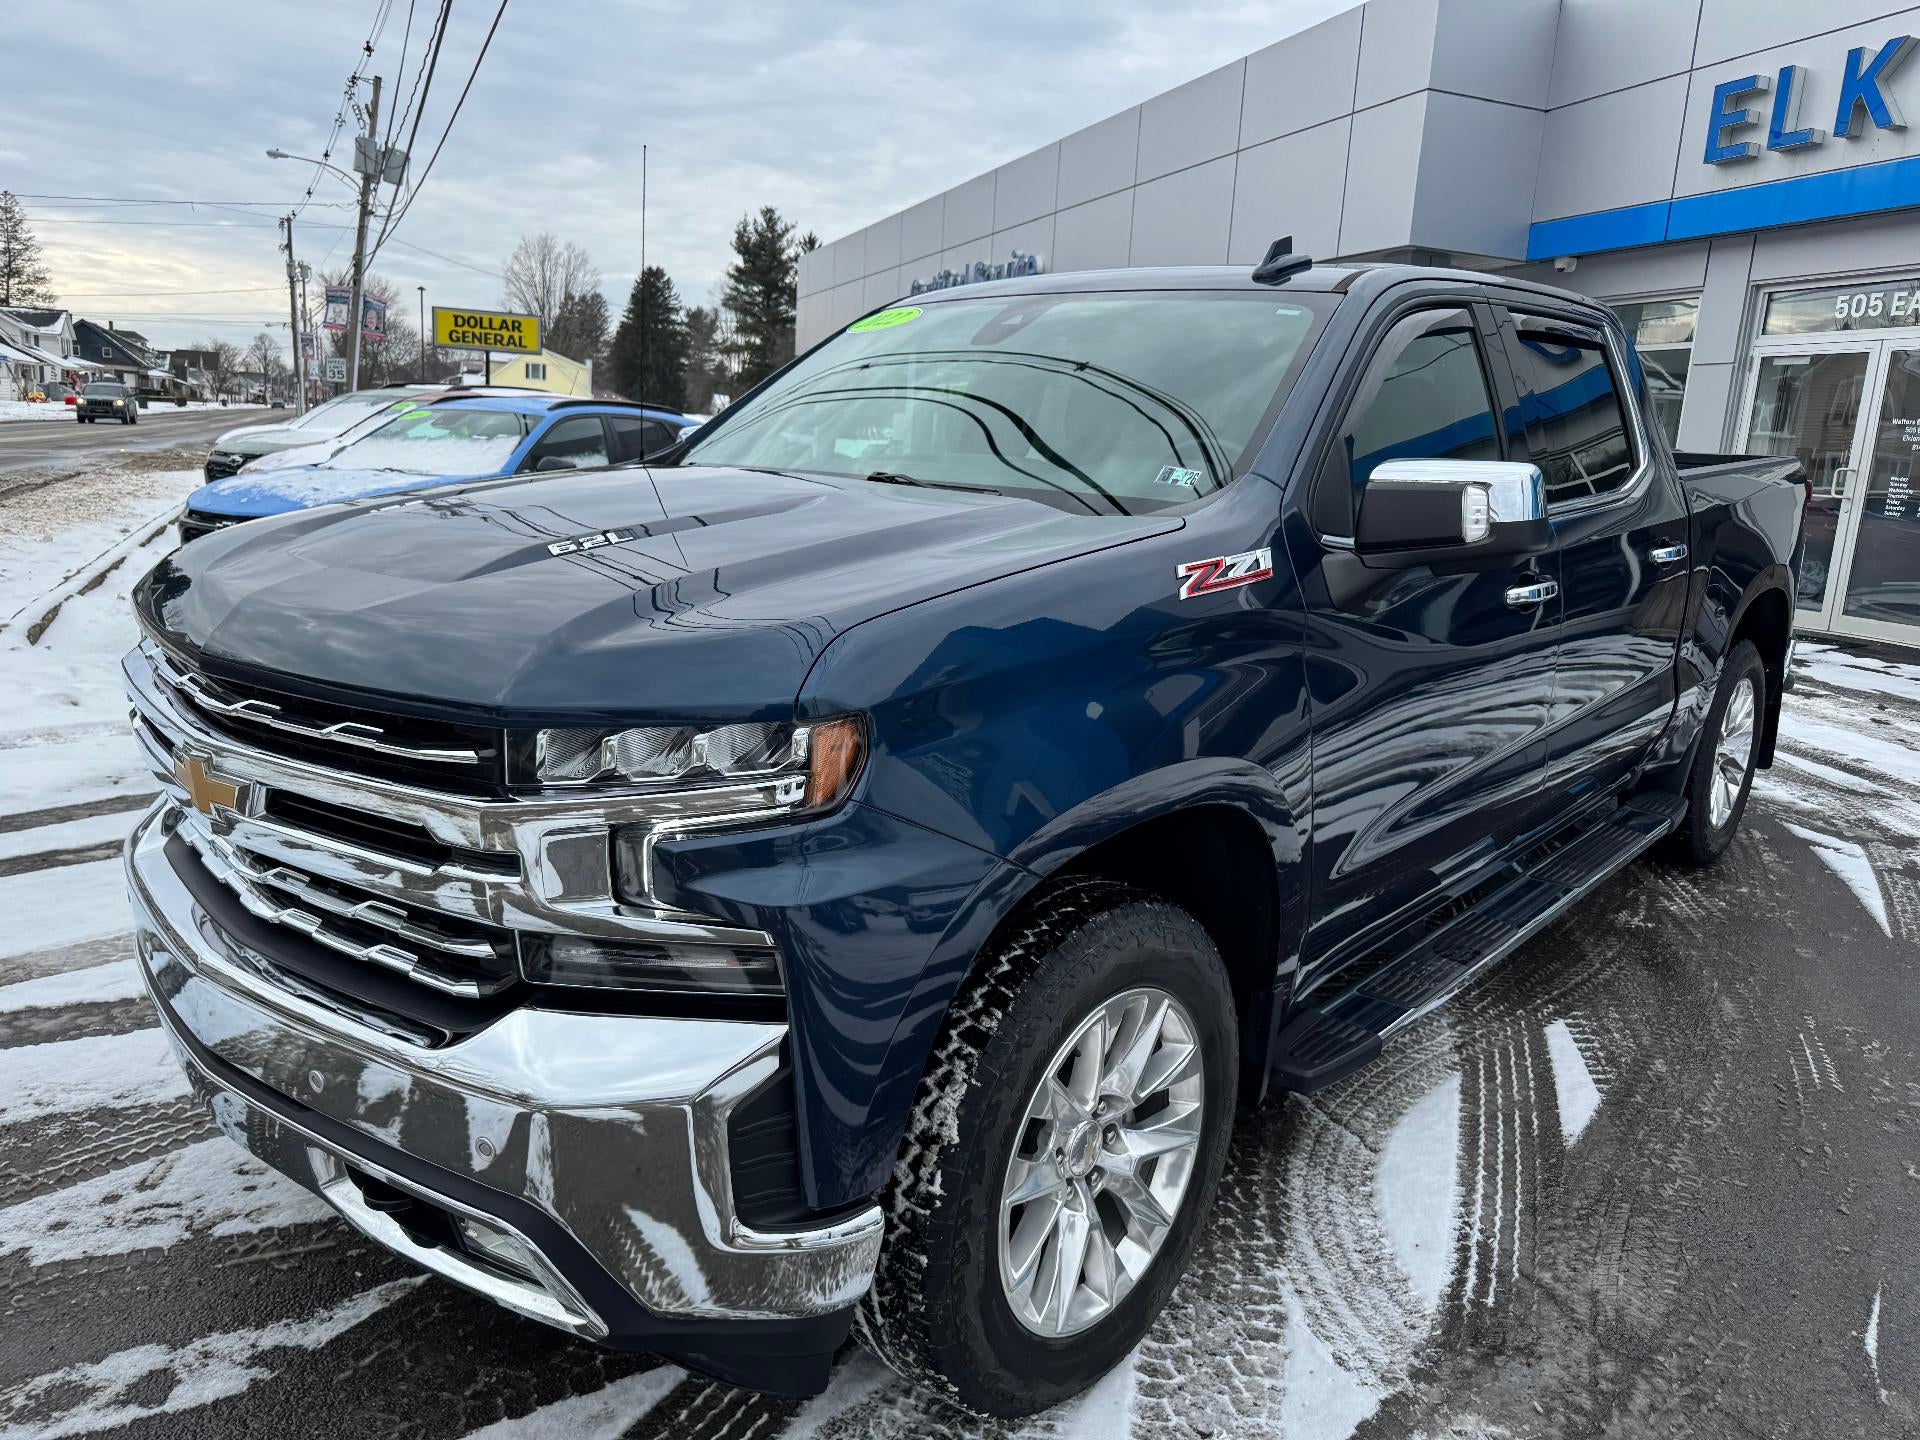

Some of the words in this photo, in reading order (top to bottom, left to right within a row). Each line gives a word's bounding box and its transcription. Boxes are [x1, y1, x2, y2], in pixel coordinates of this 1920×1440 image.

[1834, 292, 1885, 319] 505
[453, 314, 522, 333] DOLLAR
[448, 330, 528, 349] GENERAL
[328, 369, 345, 380] 35
[1175, 547, 1274, 601] Z71
